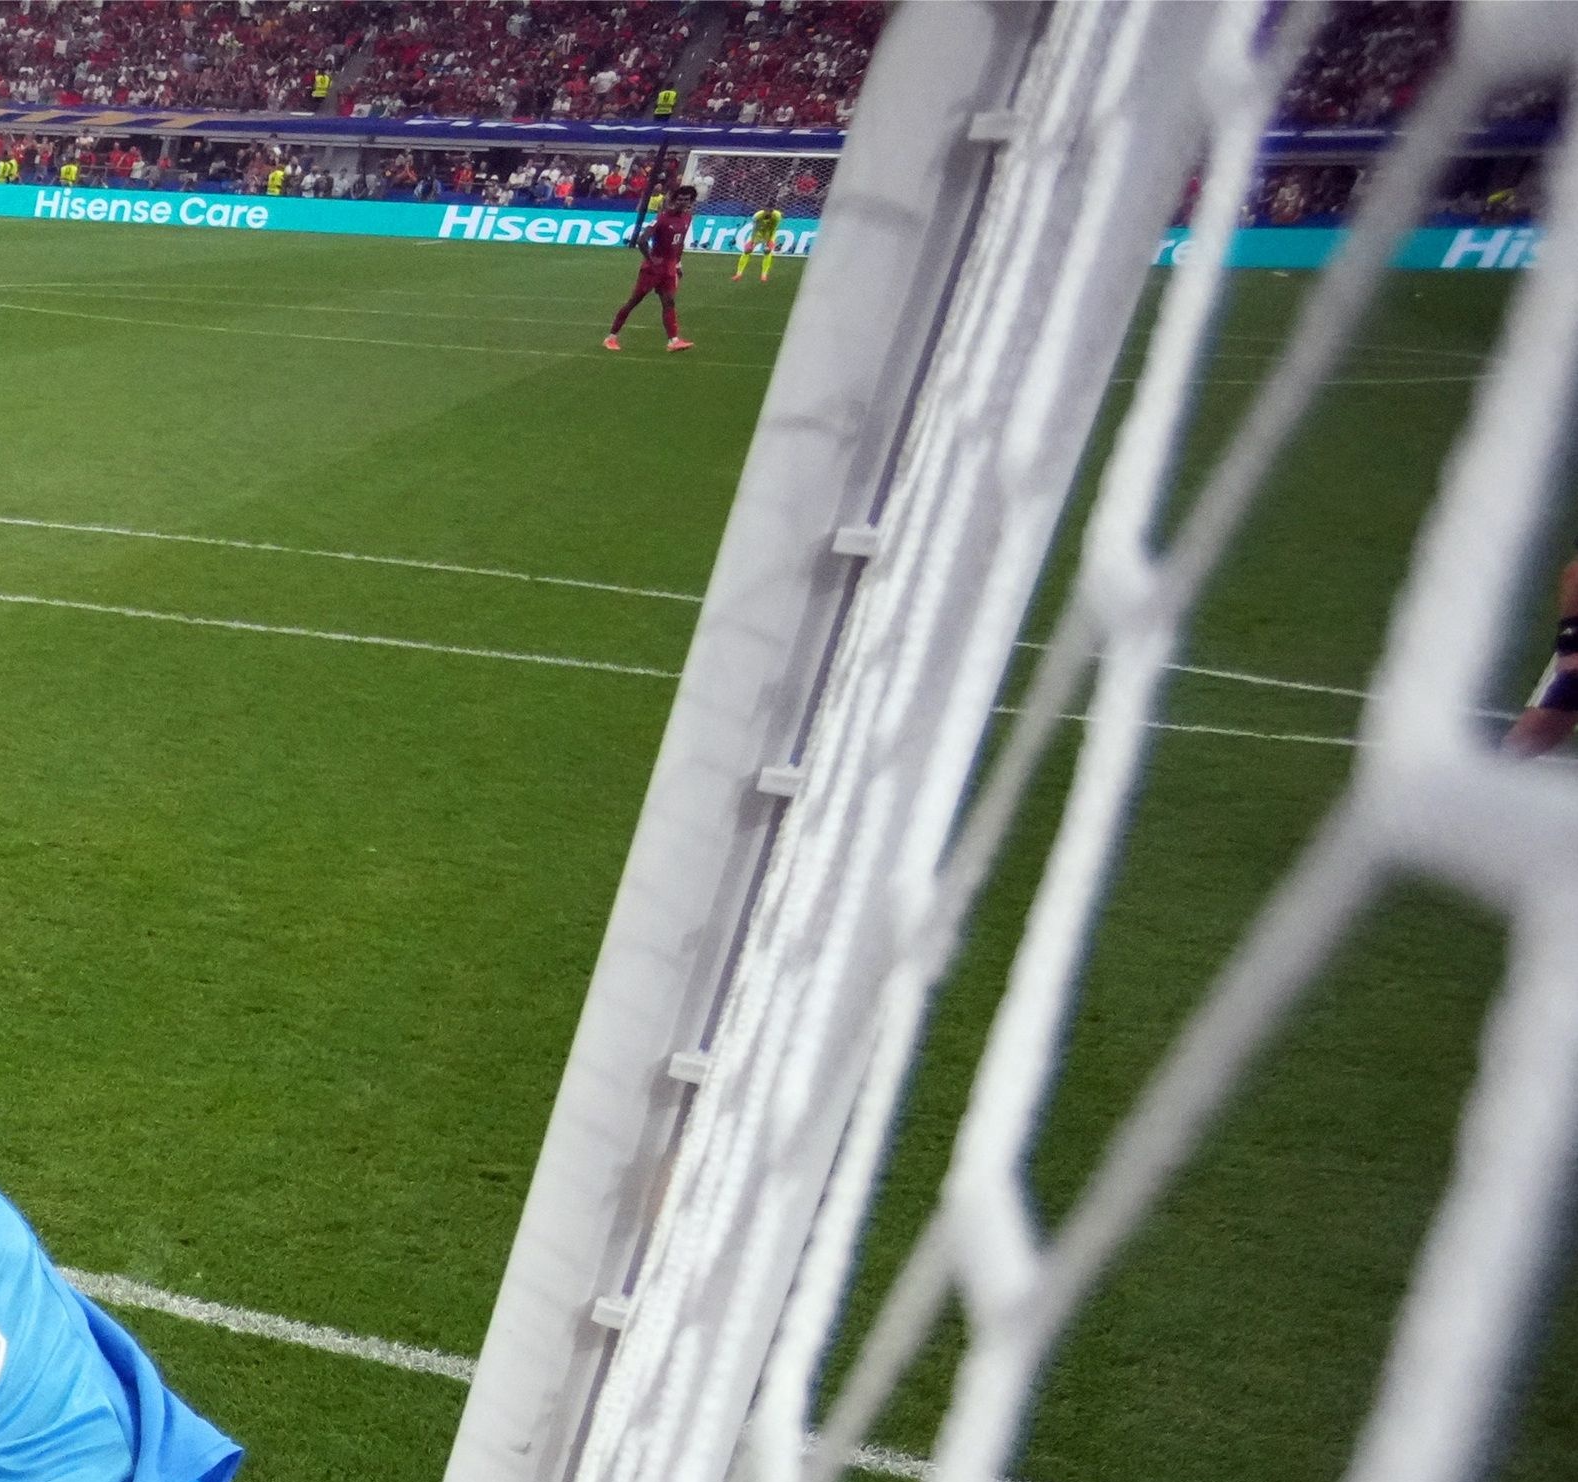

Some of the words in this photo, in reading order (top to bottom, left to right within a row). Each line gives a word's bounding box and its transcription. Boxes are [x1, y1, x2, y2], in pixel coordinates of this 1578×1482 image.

[589, 124, 850, 135] WORL
[34, 188, 172, 224] Hisense
[180, 197, 269, 229] Care
